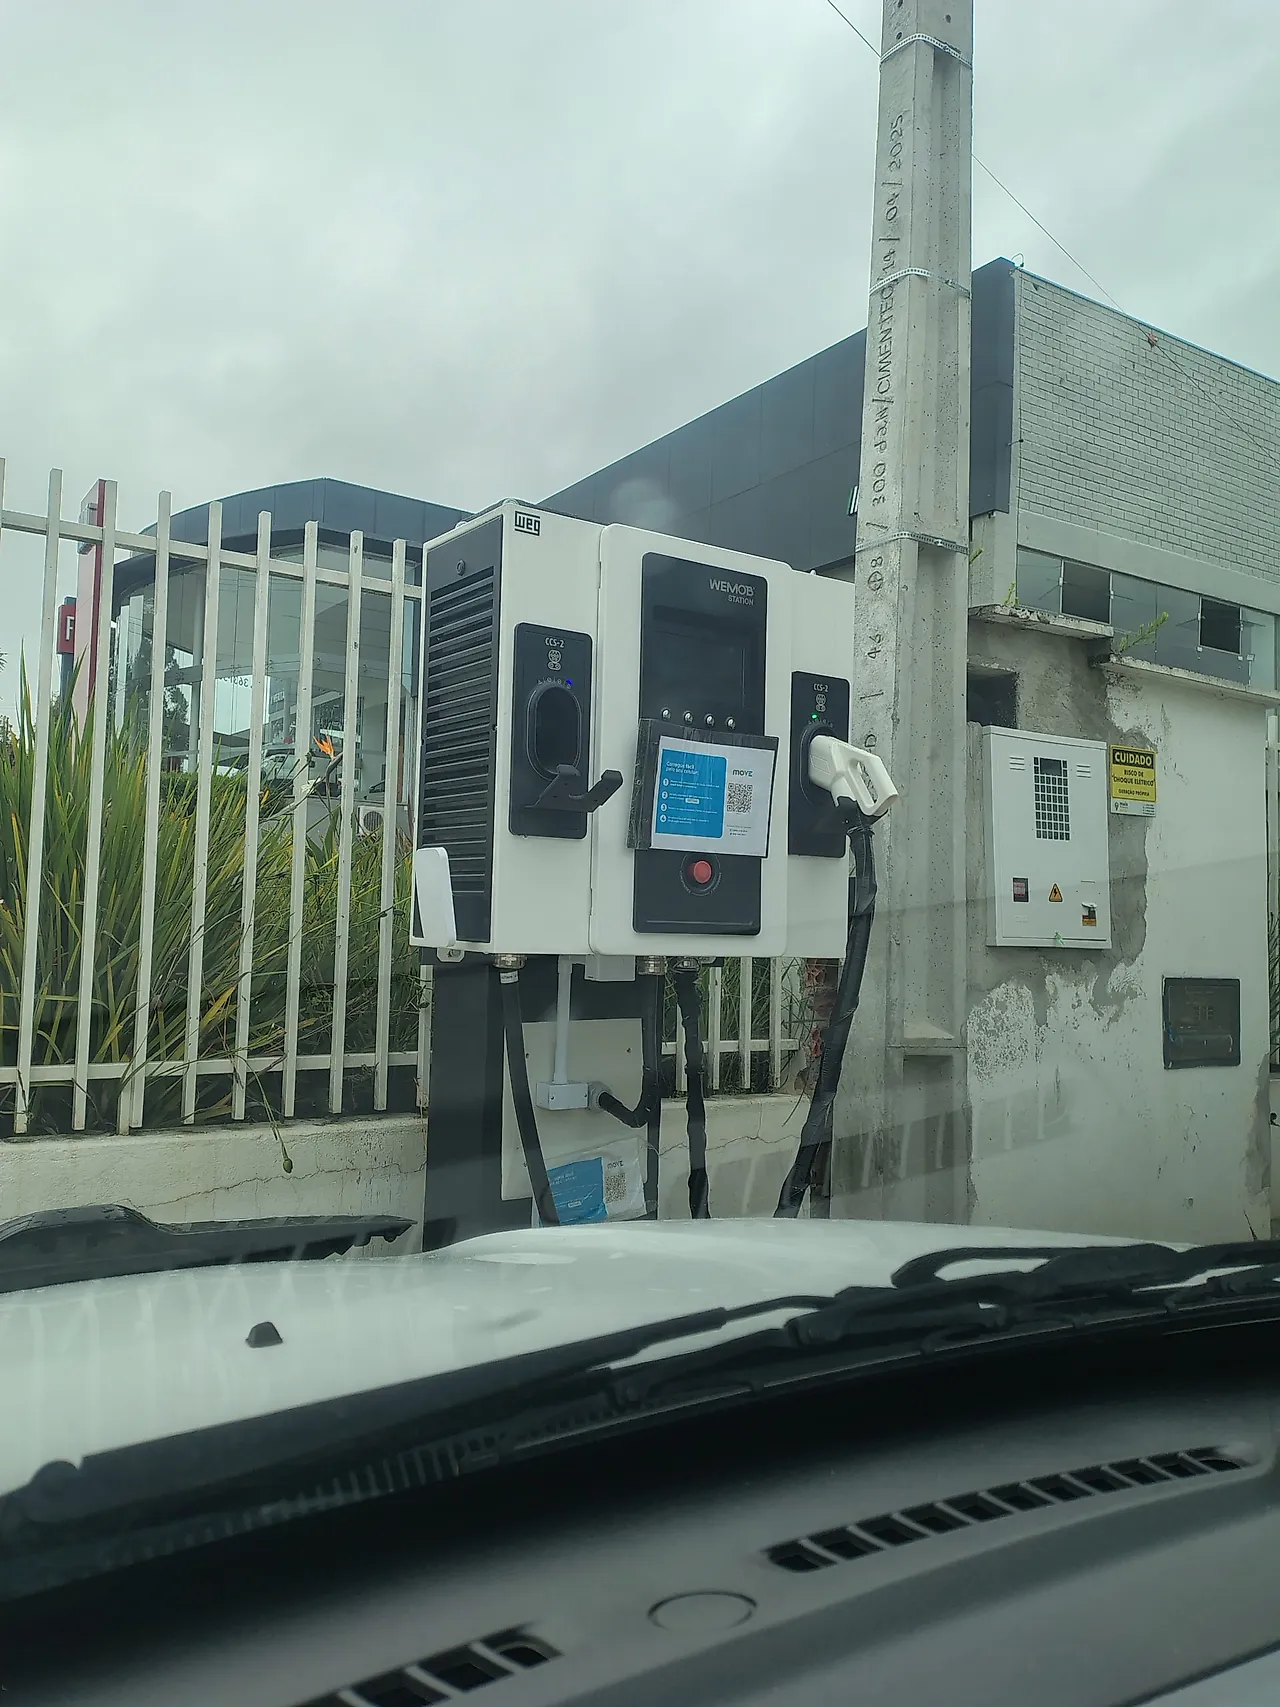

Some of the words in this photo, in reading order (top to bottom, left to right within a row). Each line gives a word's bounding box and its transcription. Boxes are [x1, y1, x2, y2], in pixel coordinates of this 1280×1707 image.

[709, 578, 755, 596] WEMOB
[728, 594, 754, 606] STATION
[544, 637, 565, 649] CCS-2
[813, 683, 829, 693] CCS-2
[1114, 752, 1152, 766] CUIDADO
[1124, 769, 1137, 777] RISCO
[1114, 776, 1133, 785] CHOQUE
